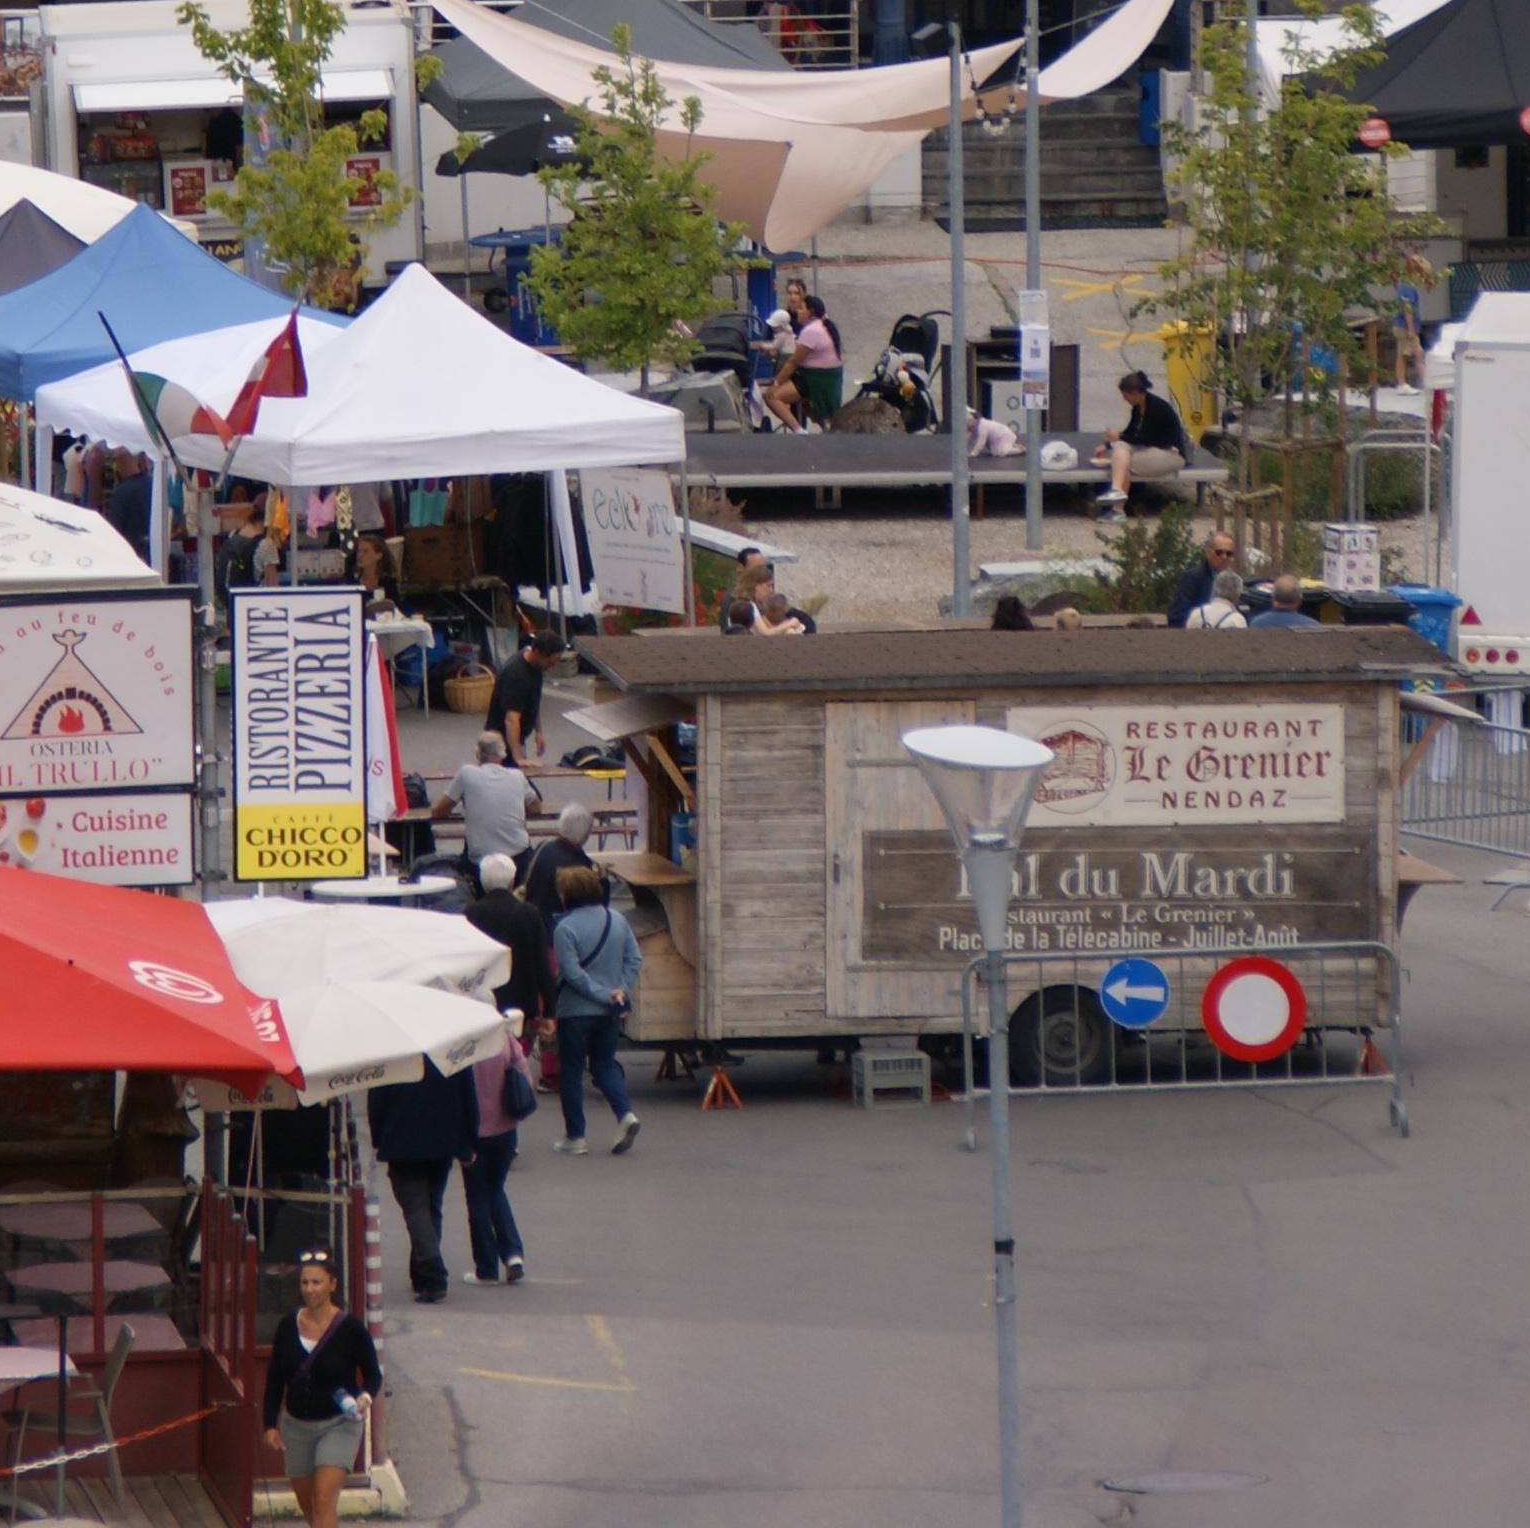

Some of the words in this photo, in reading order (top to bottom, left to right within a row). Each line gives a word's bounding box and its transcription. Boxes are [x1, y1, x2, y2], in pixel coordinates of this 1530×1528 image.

[15, 618, 43, 640] au
[57, 610, 97, 626] feu
[111, 620, 137, 642] de
[144, 645, 175, 697] bois
[246, 606, 290, 792] RISTORANTE
[293, 603, 352, 795] PIZZERIA
[1126, 719, 1324, 739] RESTAURANT
[29, 739, 114, 758] OSTERIA
[1124, 745, 1172, 784] Le
[1185, 740, 1332, 783] Grenier
[1161, 789, 1288, 810] NENDAZ
[71, 808, 169, 833] Cuisine
[245, 826, 362, 847] CHICCO
[61, 846, 180, 869] Italienne
[257, 848, 348, 869] D'ORO
[1059, 853, 1122, 900] du
[1140, 852, 1297, 901] Mardi
[1006, 906, 1091, 924] staurant
[1121, 903, 1148, 923] Le
[1154, 903, 1237, 923] Grenier
[939, 927, 985, 951] Plac
[1002, 928, 1025, 950] de
[1032, 928, 1050, 950] la
[1057, 926, 1163, 950] Télécabine
[1182, 925, 1300, 948] Juillet-Août
